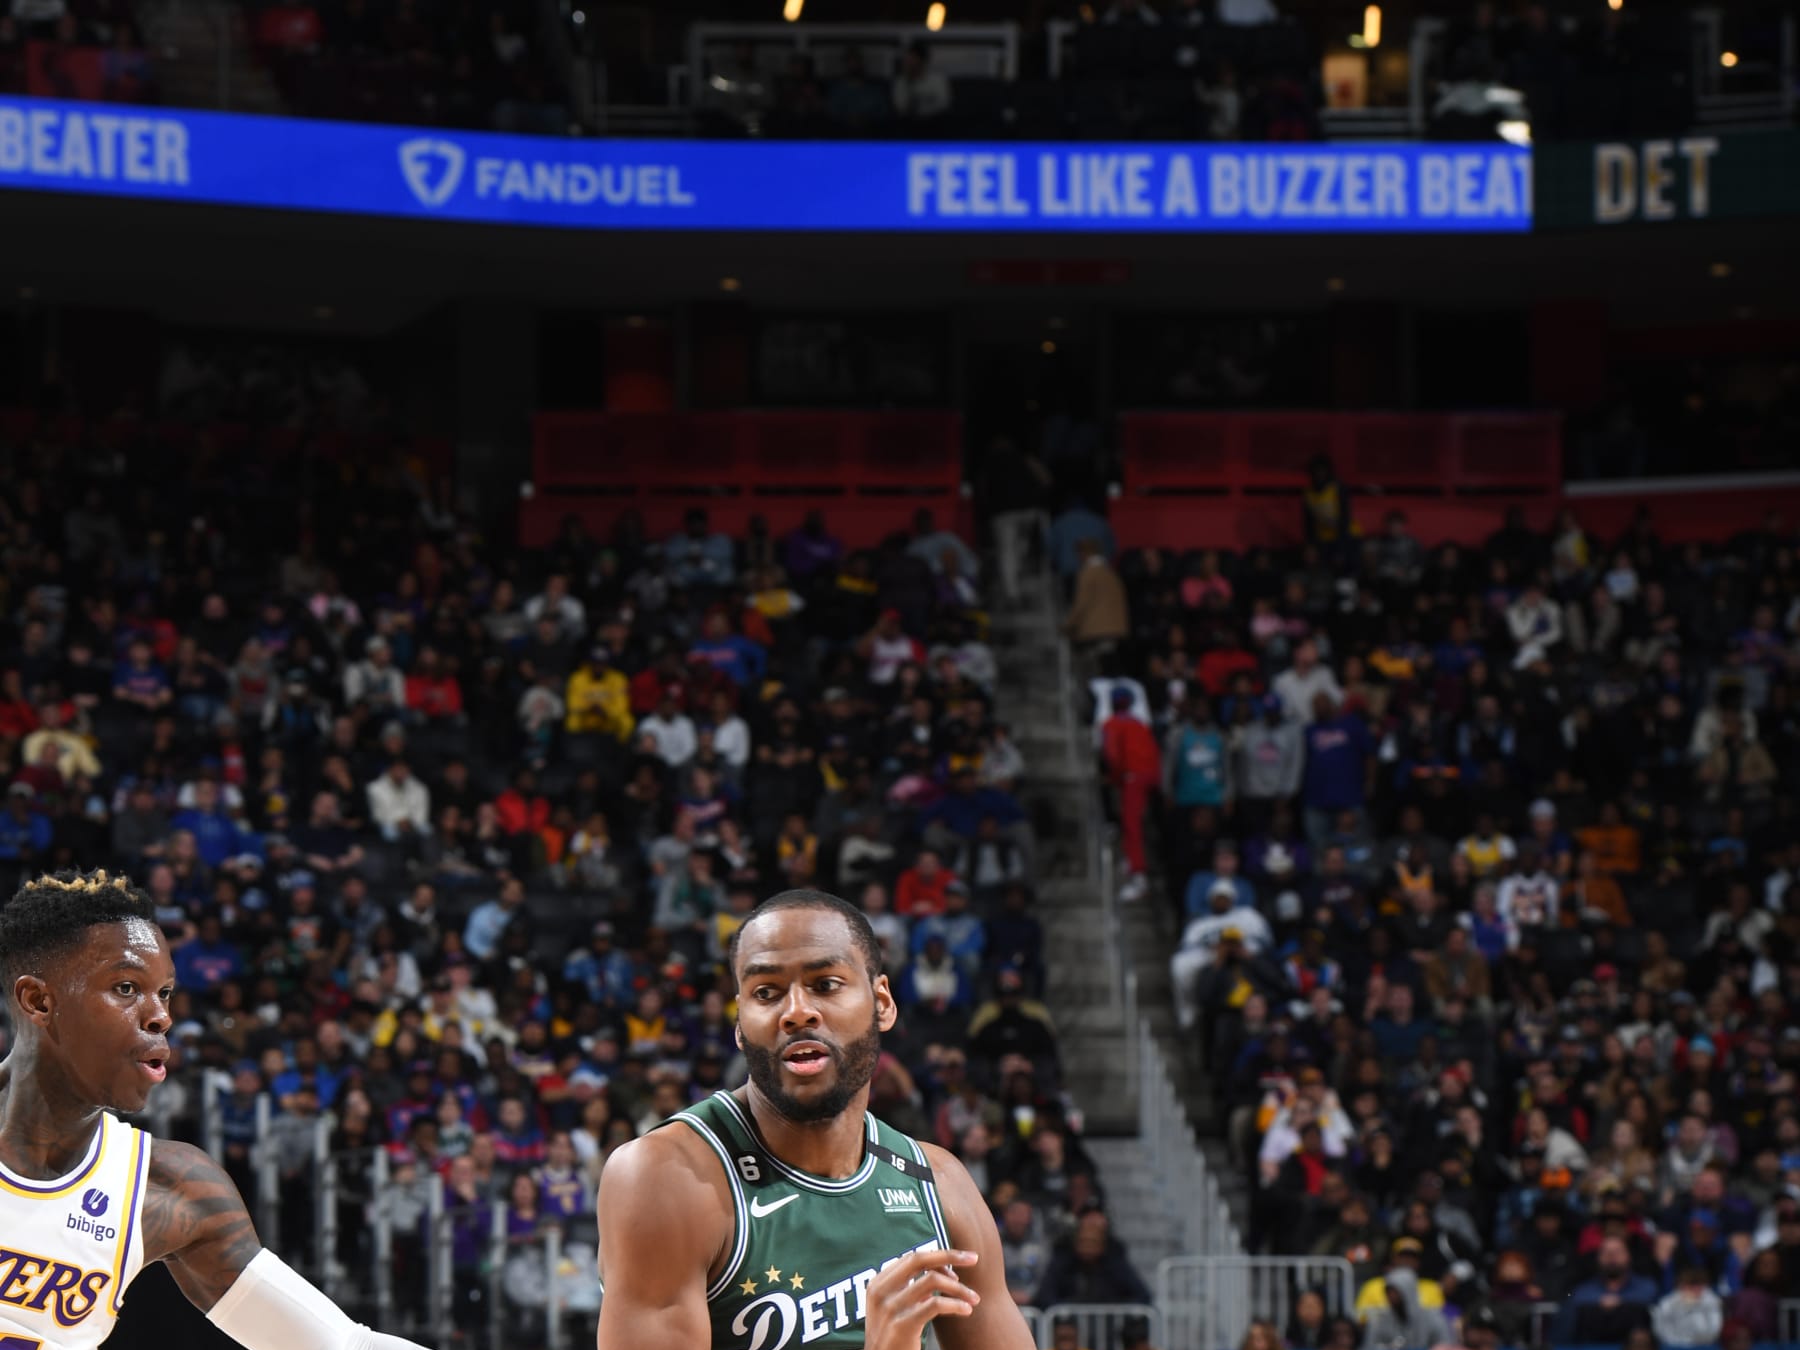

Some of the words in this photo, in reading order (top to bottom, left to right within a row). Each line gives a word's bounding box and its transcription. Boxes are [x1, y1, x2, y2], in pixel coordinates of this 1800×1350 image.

[0, 107, 190, 184] BEATER
[474, 157, 696, 206] FANDUEL
[906, 153, 1029, 217] FEEL
[1038, 153, 1154, 217] LIKE
[1162, 153, 1200, 217] A
[1207, 153, 1409, 218] BUZZER
[1594, 137, 1719, 222] DET
[738, 1156, 761, 1181] 6
[891, 1154, 906, 1172] 16
[877, 1188, 920, 1207] UWM
[67, 1213, 116, 1242] bibigo
[0, 1246, 112, 1328] ERS
